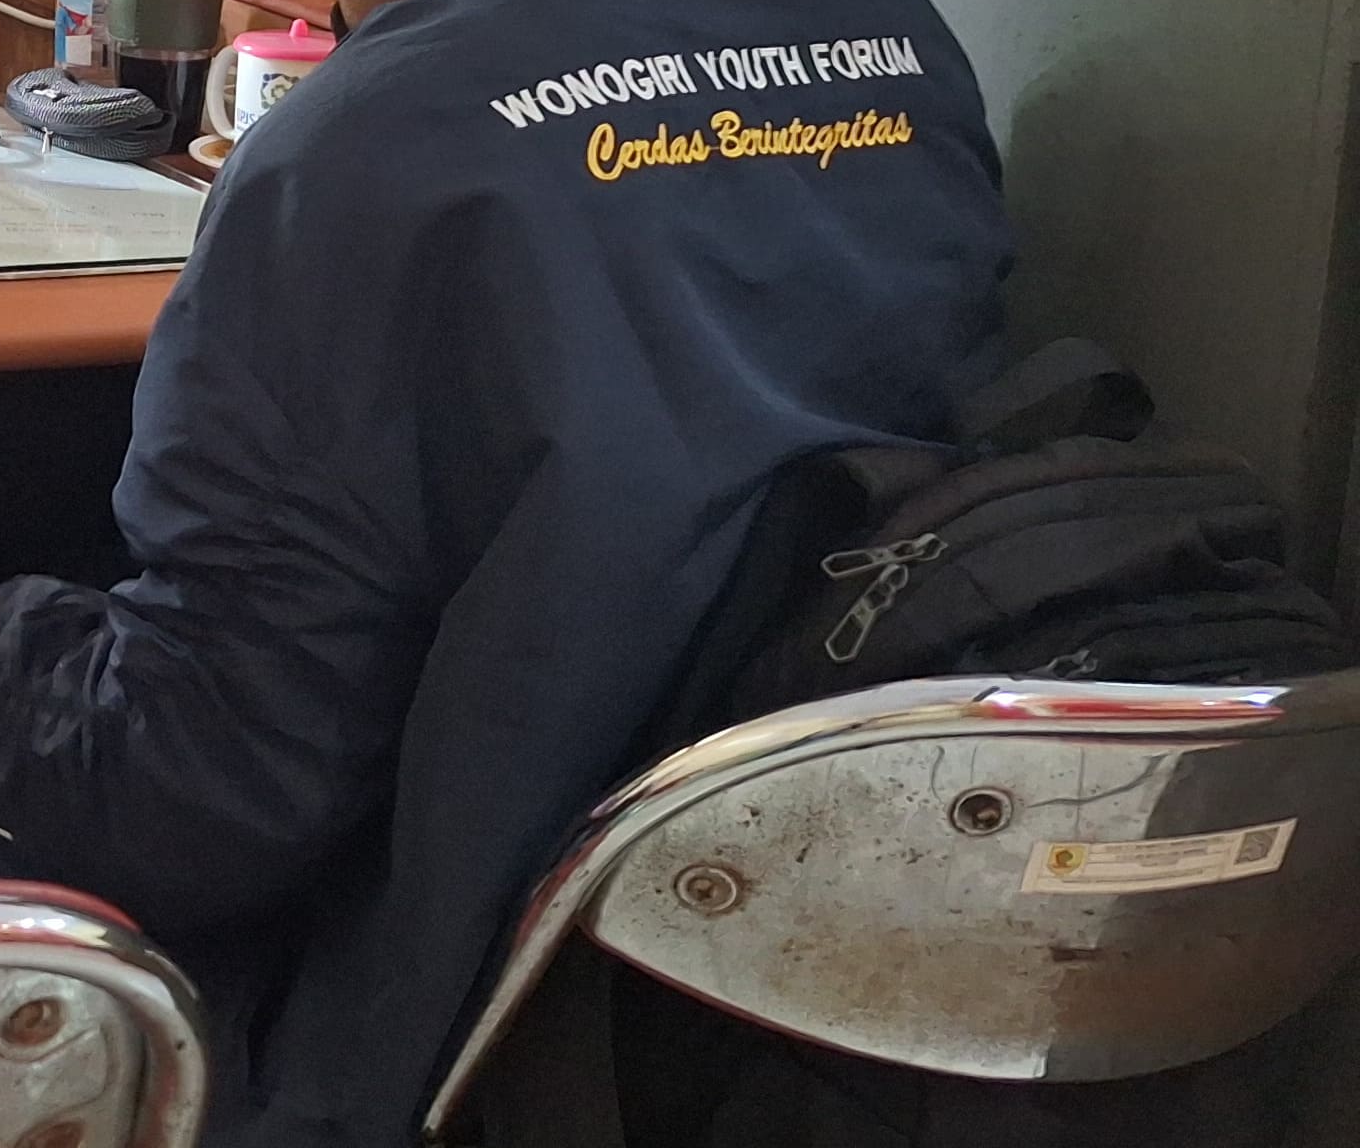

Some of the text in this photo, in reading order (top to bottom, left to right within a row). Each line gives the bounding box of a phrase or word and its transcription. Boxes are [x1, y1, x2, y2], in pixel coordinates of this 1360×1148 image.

[490, 36, 925, 129] WONOGIRI YOUTH FORUM
[587, 109, 914, 182] Cerdas Berintegritas
